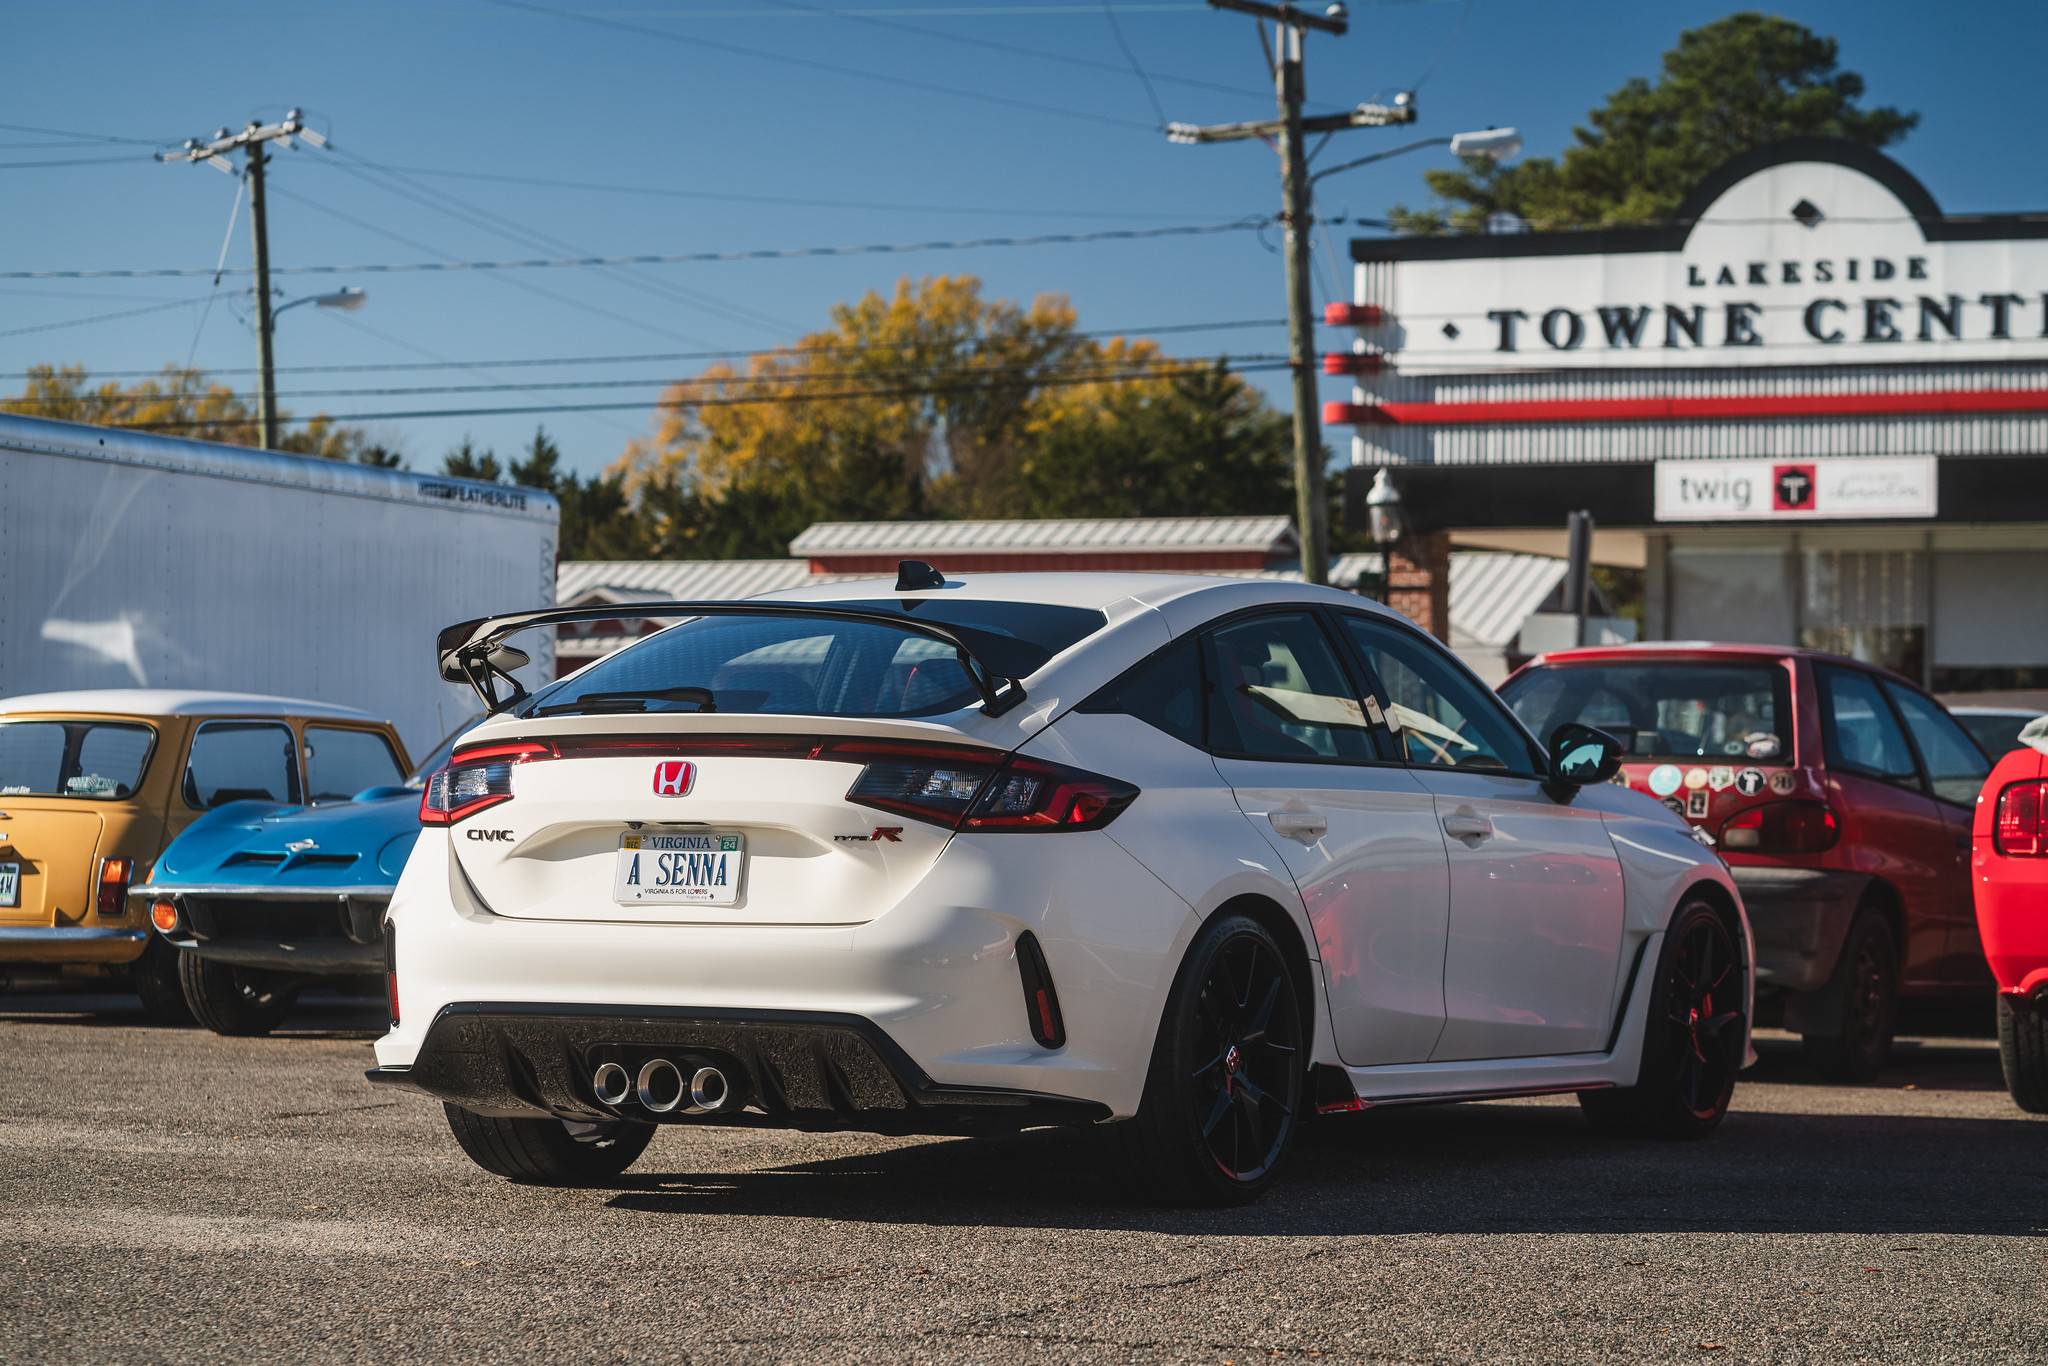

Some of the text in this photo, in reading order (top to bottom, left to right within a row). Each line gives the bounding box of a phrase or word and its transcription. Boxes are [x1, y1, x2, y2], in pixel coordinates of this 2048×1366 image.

[1687, 256, 1929, 287] LAKESIDE
[1487, 290, 2048, 352] TOWNE CENT
[452, 485, 527, 511] FEATHERLITE
[1680, 472, 1752, 510] twig
[466, 829, 515, 842] CIVIC
[652, 836, 711, 849] VIRGINIA
[723, 841, 736, 850] 24
[869, 826, 904, 842] R
[626, 853, 727, 887] A SENNA
